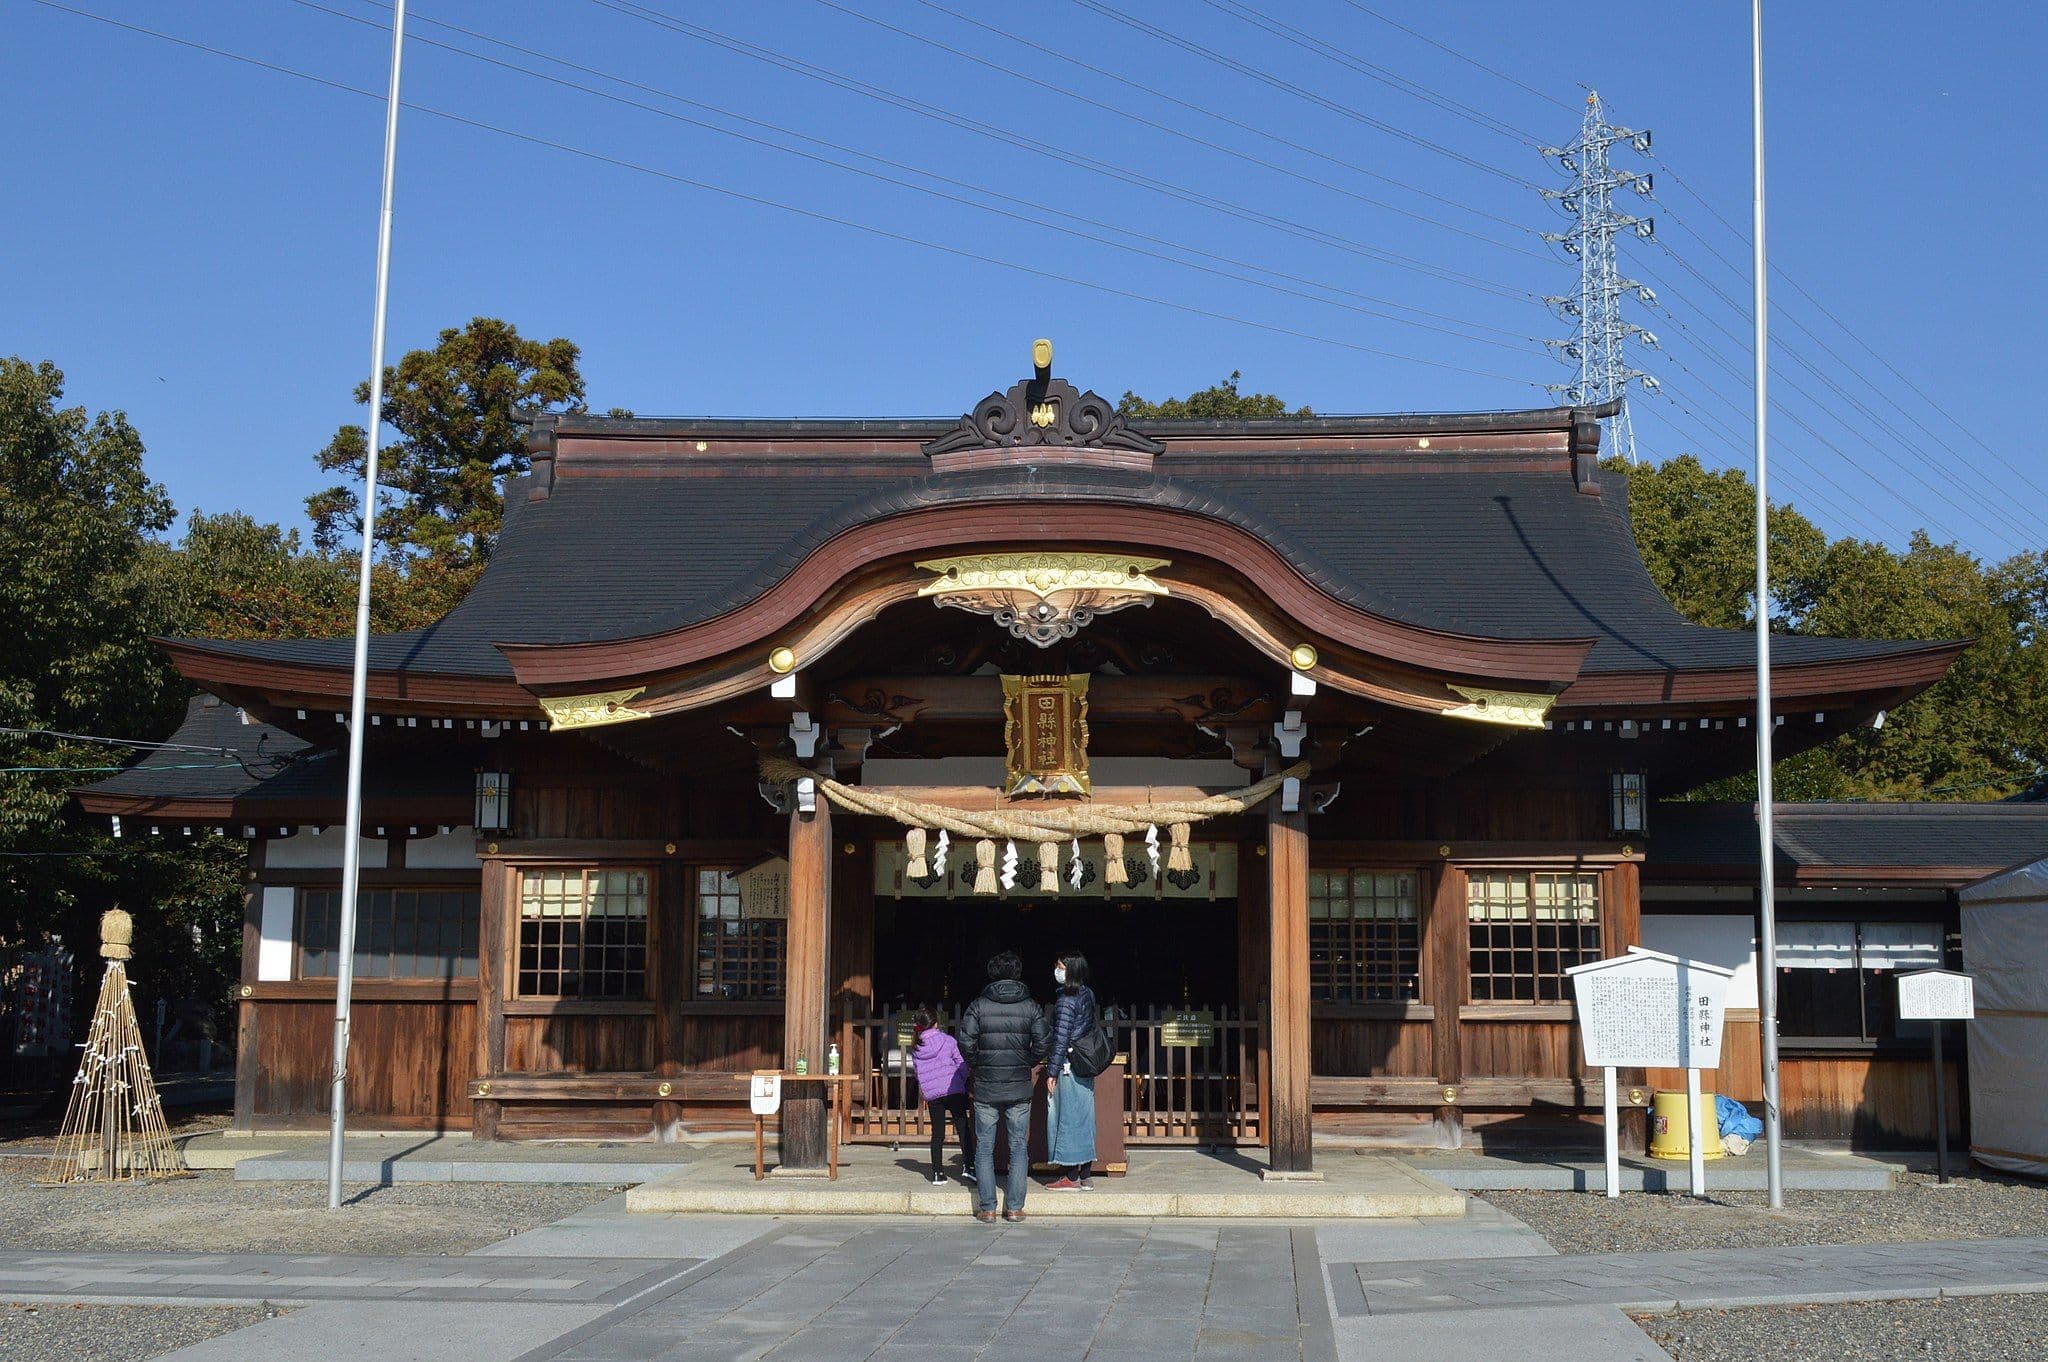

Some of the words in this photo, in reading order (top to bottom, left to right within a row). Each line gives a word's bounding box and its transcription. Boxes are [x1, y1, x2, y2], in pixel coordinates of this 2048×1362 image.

[1037, 697, 1057, 765] 田縣神社
[1698, 996, 1712, 1047] 田縣神社
